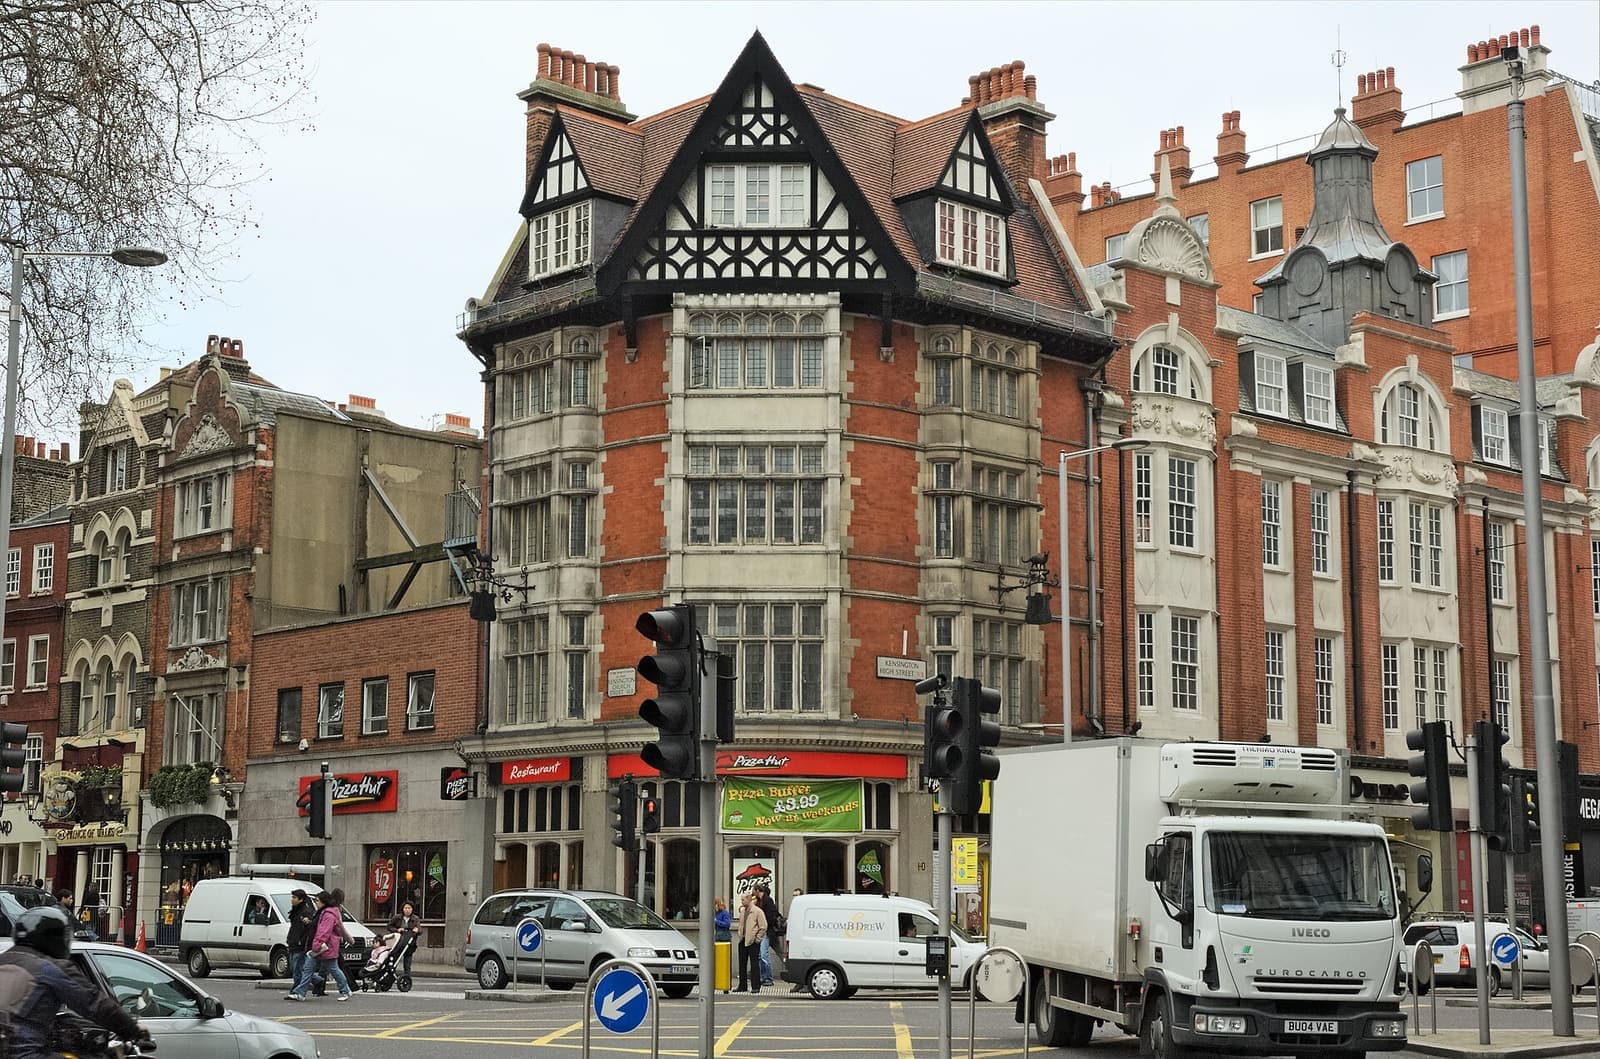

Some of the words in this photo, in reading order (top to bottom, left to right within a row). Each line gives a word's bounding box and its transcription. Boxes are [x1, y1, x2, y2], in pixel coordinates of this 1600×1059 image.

[886, 660, 919, 669] KENSINGTON
[895, 669, 914, 677] STREET
[733, 755, 764, 767] Pizza
[765, 755, 790, 766] Hut
[510, 761, 562, 779] Restaurant
[331, 778, 358, 799] Pizza
[359, 775, 387, 796] Hut
[446, 776, 468, 794] Pizza
[451, 785, 466, 796] Hut
[1350, 776, 1410, 801] Dune
[728, 787, 765, 801] Pizza
[768, 784, 811, 798] Buffet
[773, 794, 819, 814] £3.99
[754, 814, 782, 827] Now
[66, 829, 87, 840] PRINCE
[87, 829, 95, 839] OF
[97, 827, 115, 838] WALES
[374, 867, 390, 890] 1/2
[737, 875, 772, 895] Pizza
[375, 889, 388, 899] price
[808, 920, 854, 930] BASCOMB
[856, 921, 885, 931] DREW
[1291, 928, 1331, 938] IVECO
[1256, 968, 1366, 978] EUROCARGO
[1288, 1021, 1313, 1032] BU04
[1317, 1022, 1334, 1032] VAE
